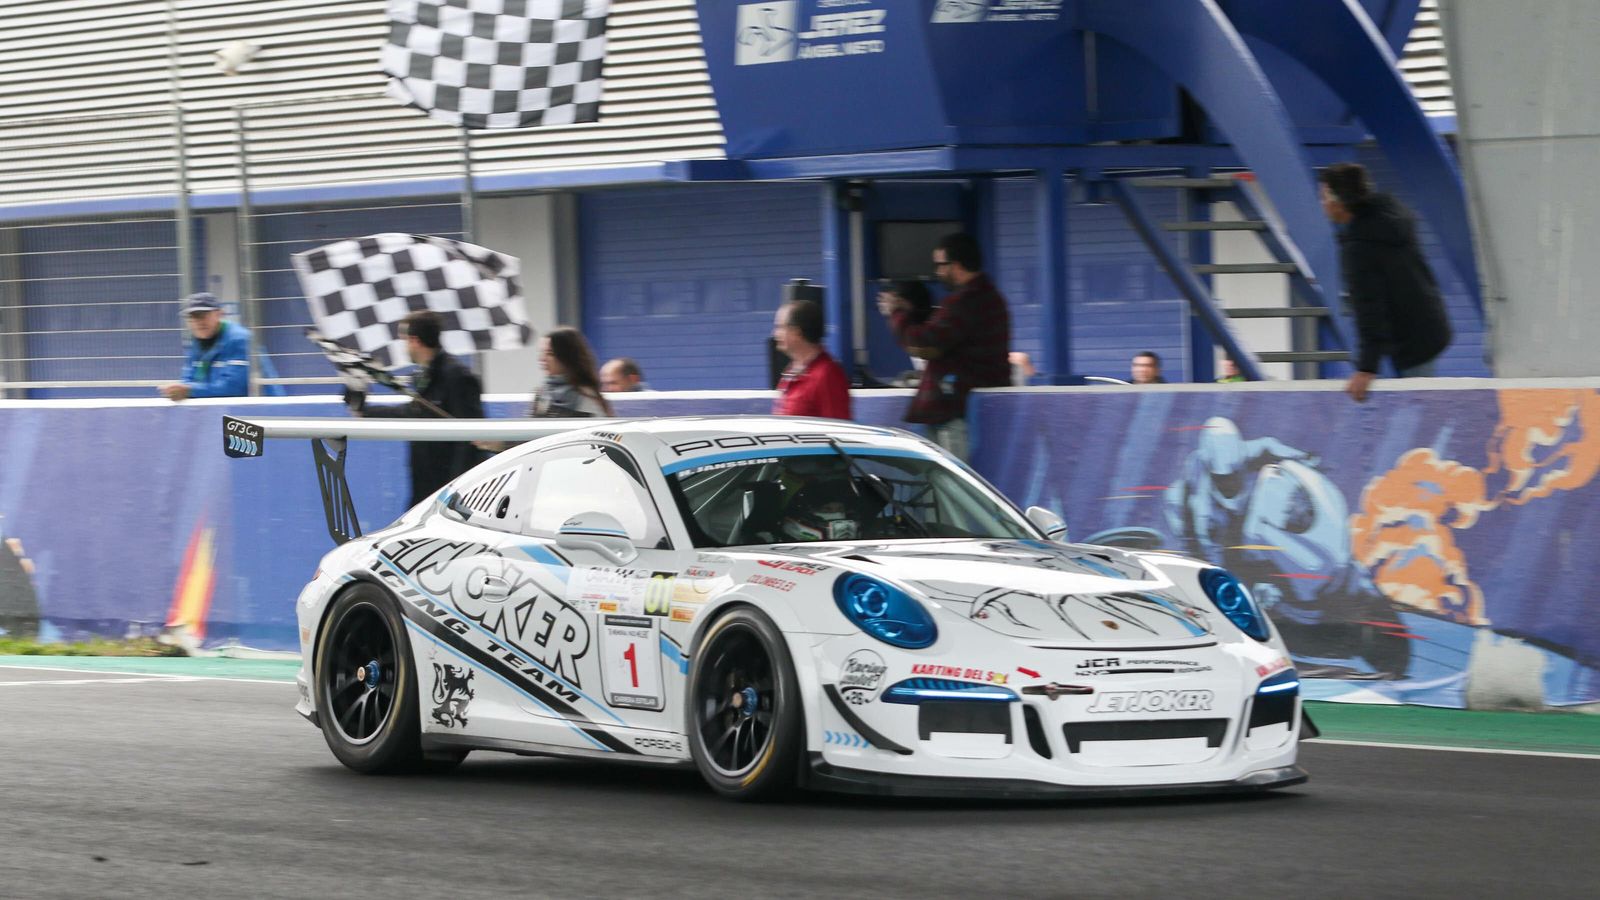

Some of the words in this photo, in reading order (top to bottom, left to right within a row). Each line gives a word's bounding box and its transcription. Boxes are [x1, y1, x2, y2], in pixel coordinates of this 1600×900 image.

[227, 421, 246, 434] GT3
[487, 639, 582, 703] TEAM
[624, 643, 639, 688] 1
[1076, 657, 1121, 668] JCR
[911, 663, 962, 678] KARTING
[963, 667, 983, 680] DEL
[1087, 690, 1215, 713] JETJOKER
[634, 737, 683, 752] PORSCHE
